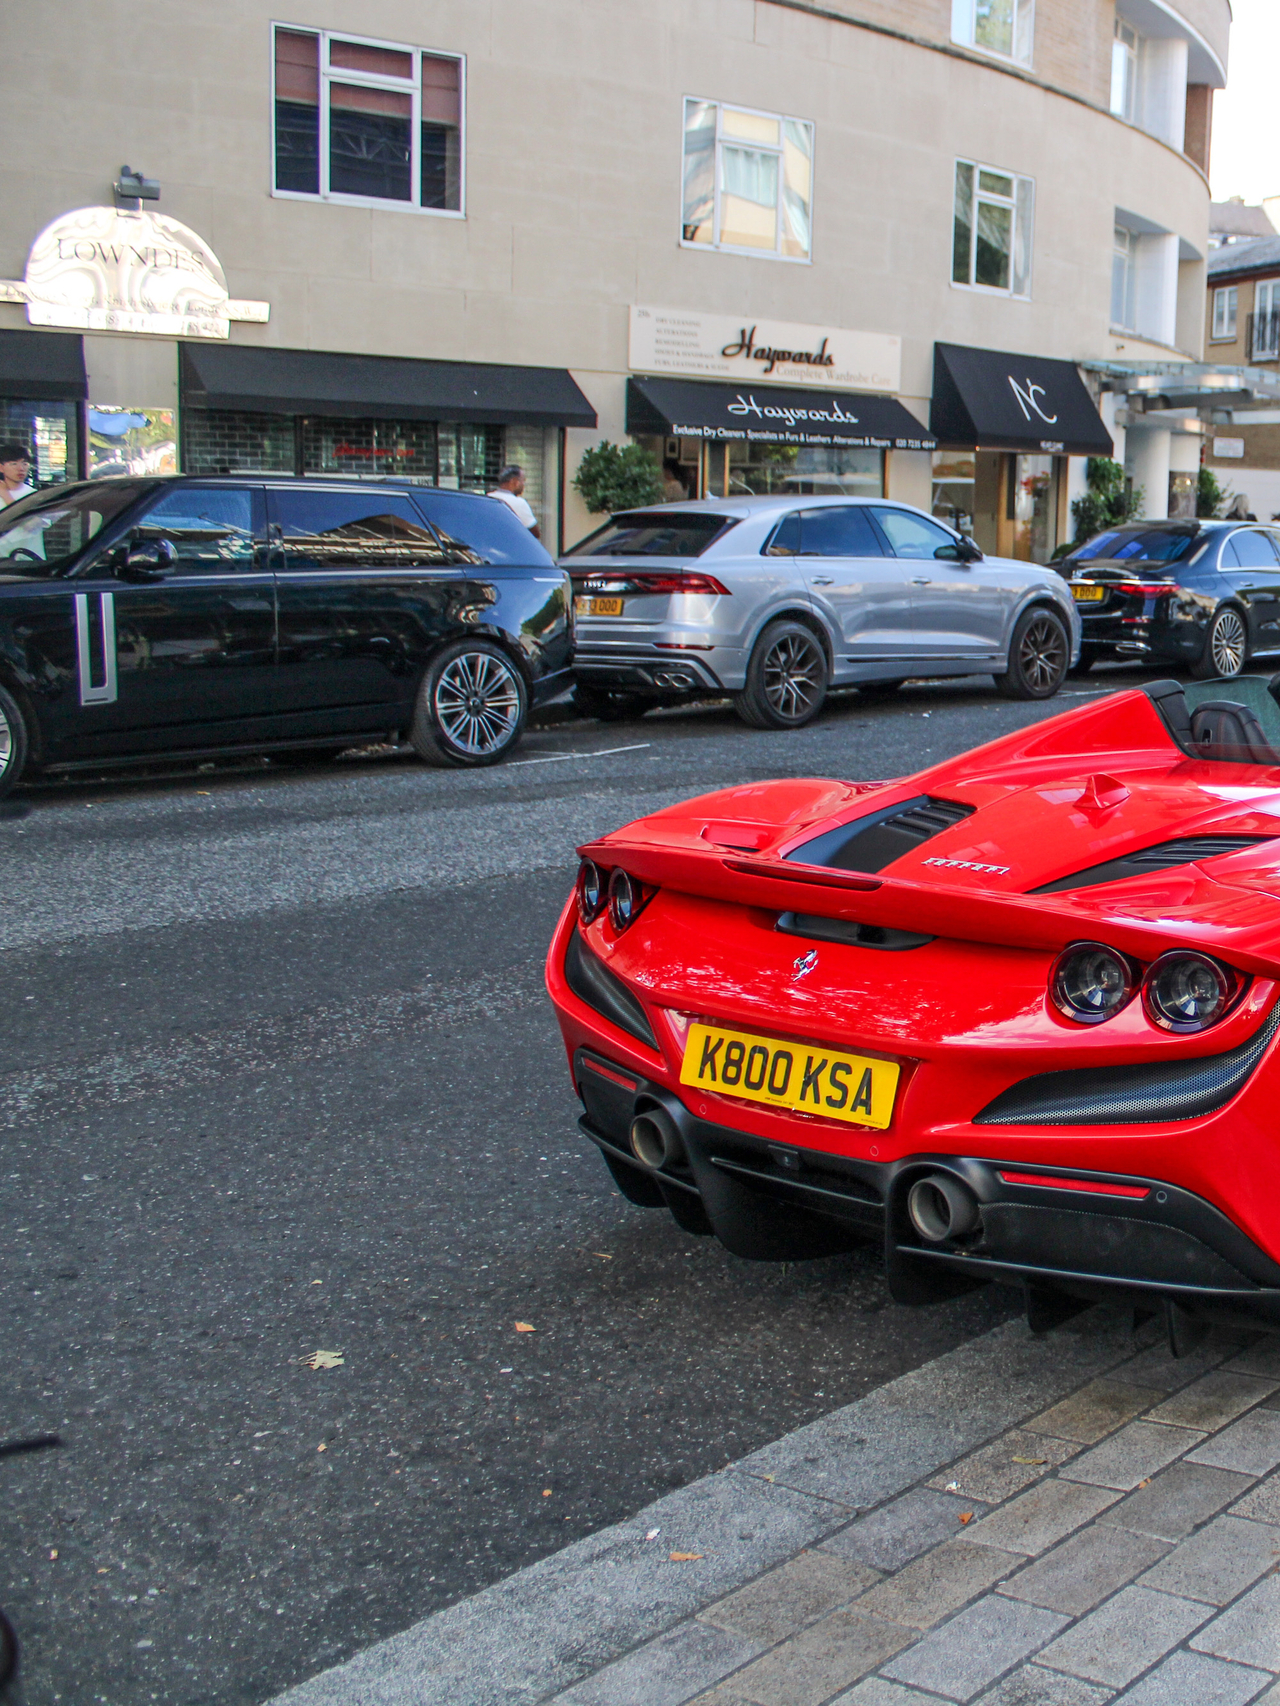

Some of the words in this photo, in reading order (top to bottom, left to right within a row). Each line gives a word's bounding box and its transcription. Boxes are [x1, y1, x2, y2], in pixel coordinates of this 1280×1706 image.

[57, 238, 205, 270] LOWNDES
[721, 325, 835, 374] Haywards
[776, 363, 823, 381] Complete
[826, 368, 869, 384] Wardrobe
[872, 373, 891, 387] Care
[727, 394, 860, 427] Haywards
[672, 423, 702, 436] Exclusive
[703, 425, 716, 439] Dry
[717, 427, 745, 439] Cleaners
[785, 431, 798, 442] Furs
[921, 857, 1011, 875] Ferrari
[698, 1035, 793, 1096] K800
[800, 1056, 873, 1116] KSA
